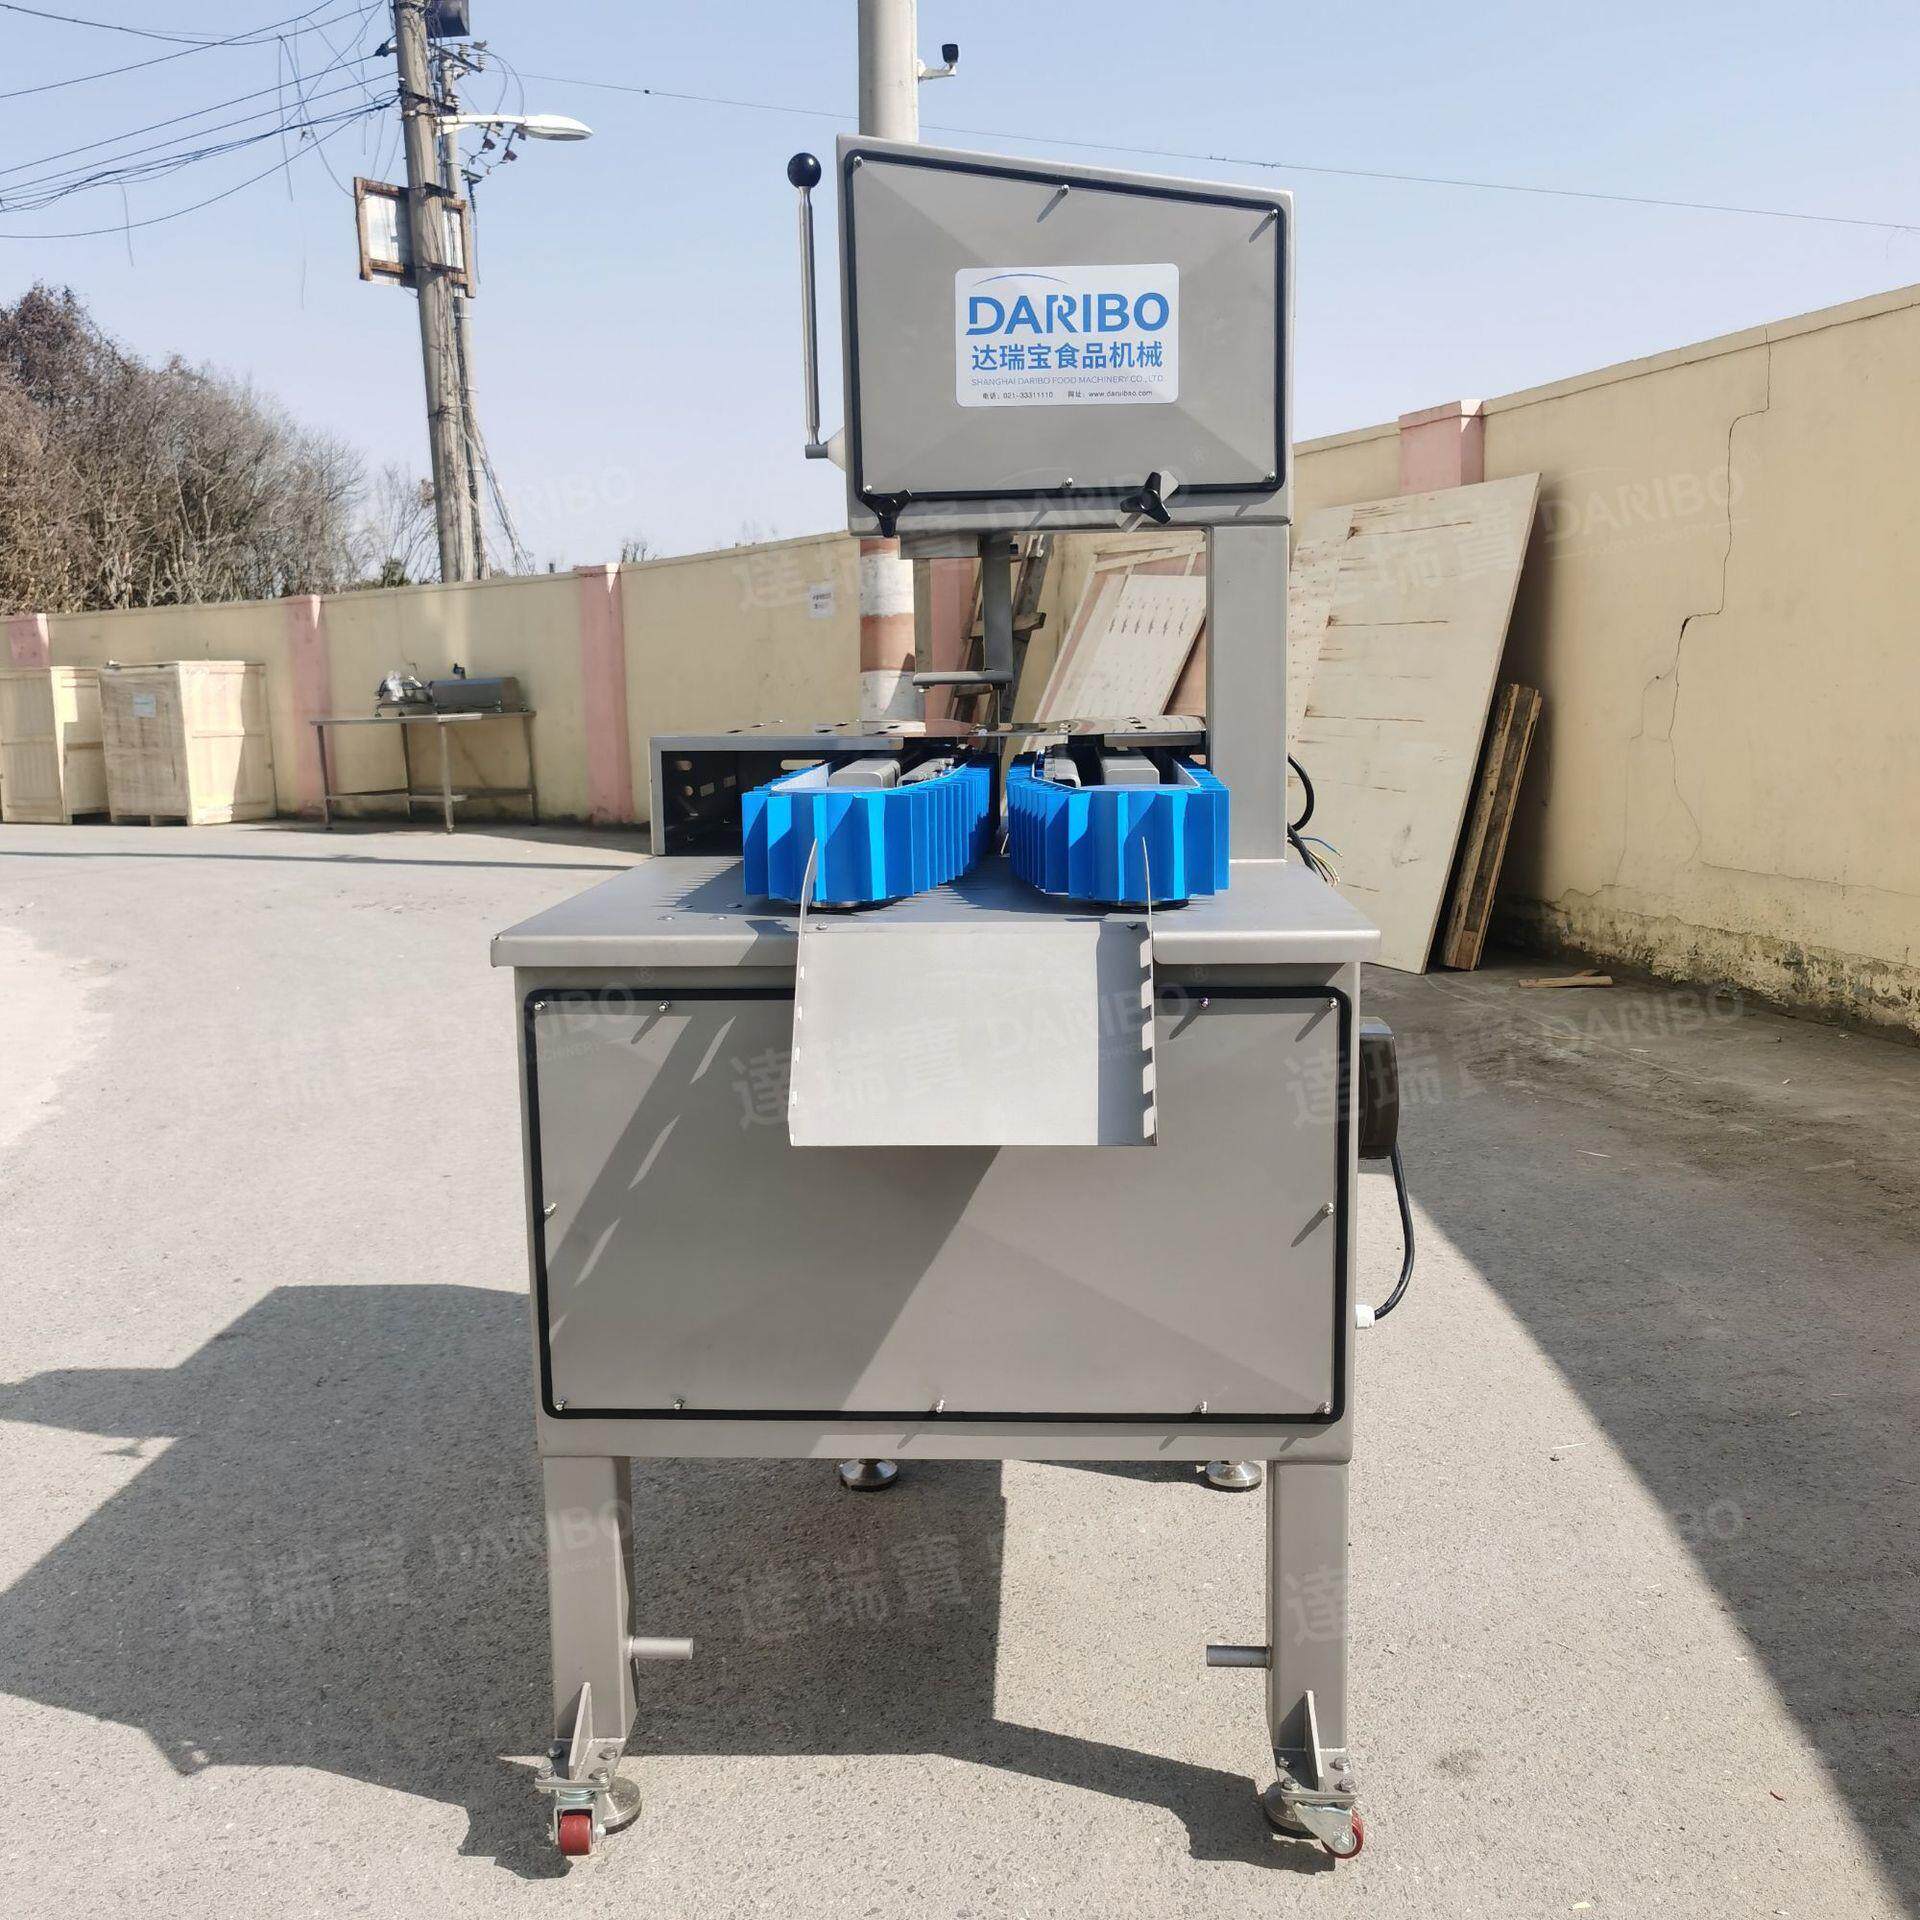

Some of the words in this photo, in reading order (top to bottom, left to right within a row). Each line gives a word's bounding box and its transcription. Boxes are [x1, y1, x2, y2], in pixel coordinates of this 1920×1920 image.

[966, 292, 1170, 335] DARIBO
[972, 340, 1163, 371] 达瑞宝食品机械
[971, 377, 1015, 386] SHANGHAI
[1017, 377, 1050, 385] DARIBO
[1052, 376, 1077, 385] FOOD
[1079, 375, 1127, 384] MACHINERY
